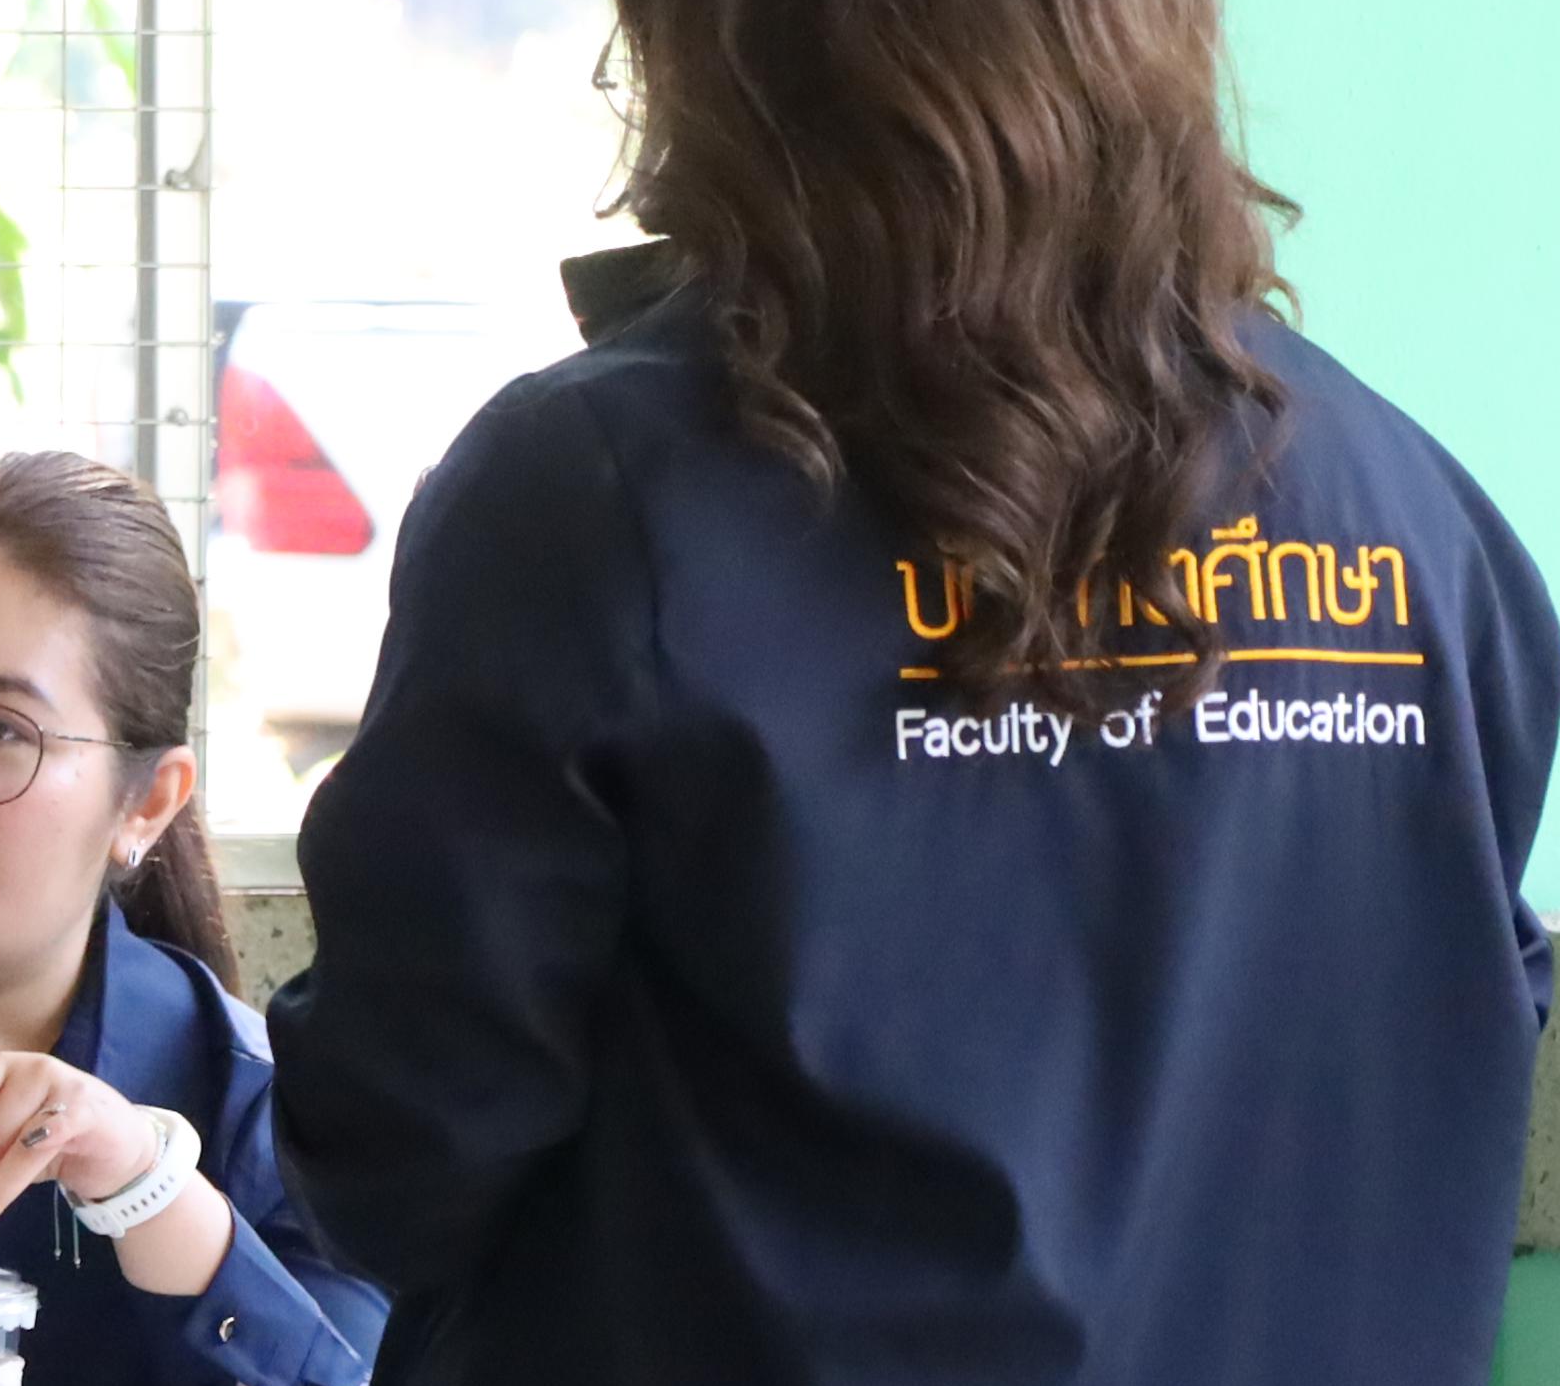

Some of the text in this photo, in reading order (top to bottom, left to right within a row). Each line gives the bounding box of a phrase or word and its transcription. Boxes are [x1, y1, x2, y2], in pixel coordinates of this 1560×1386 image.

[896, 687, 1426, 767] Faculty of Education
